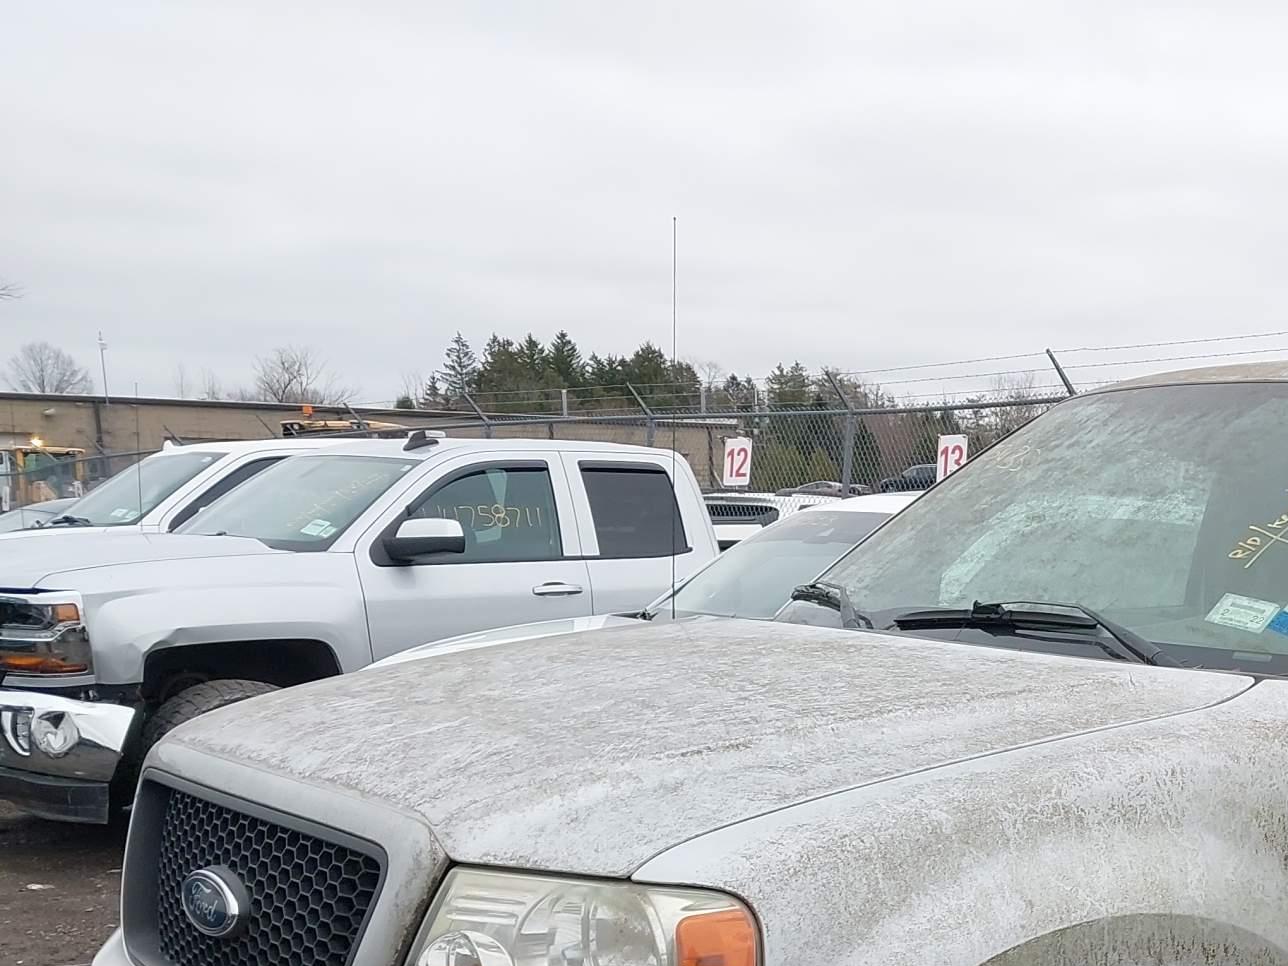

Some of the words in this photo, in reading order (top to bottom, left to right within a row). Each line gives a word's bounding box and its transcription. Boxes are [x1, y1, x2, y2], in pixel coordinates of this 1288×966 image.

[726, 447, 749, 478] 12
[940, 444, 964, 477] 13
[188, 881, 218, 922] Ford
